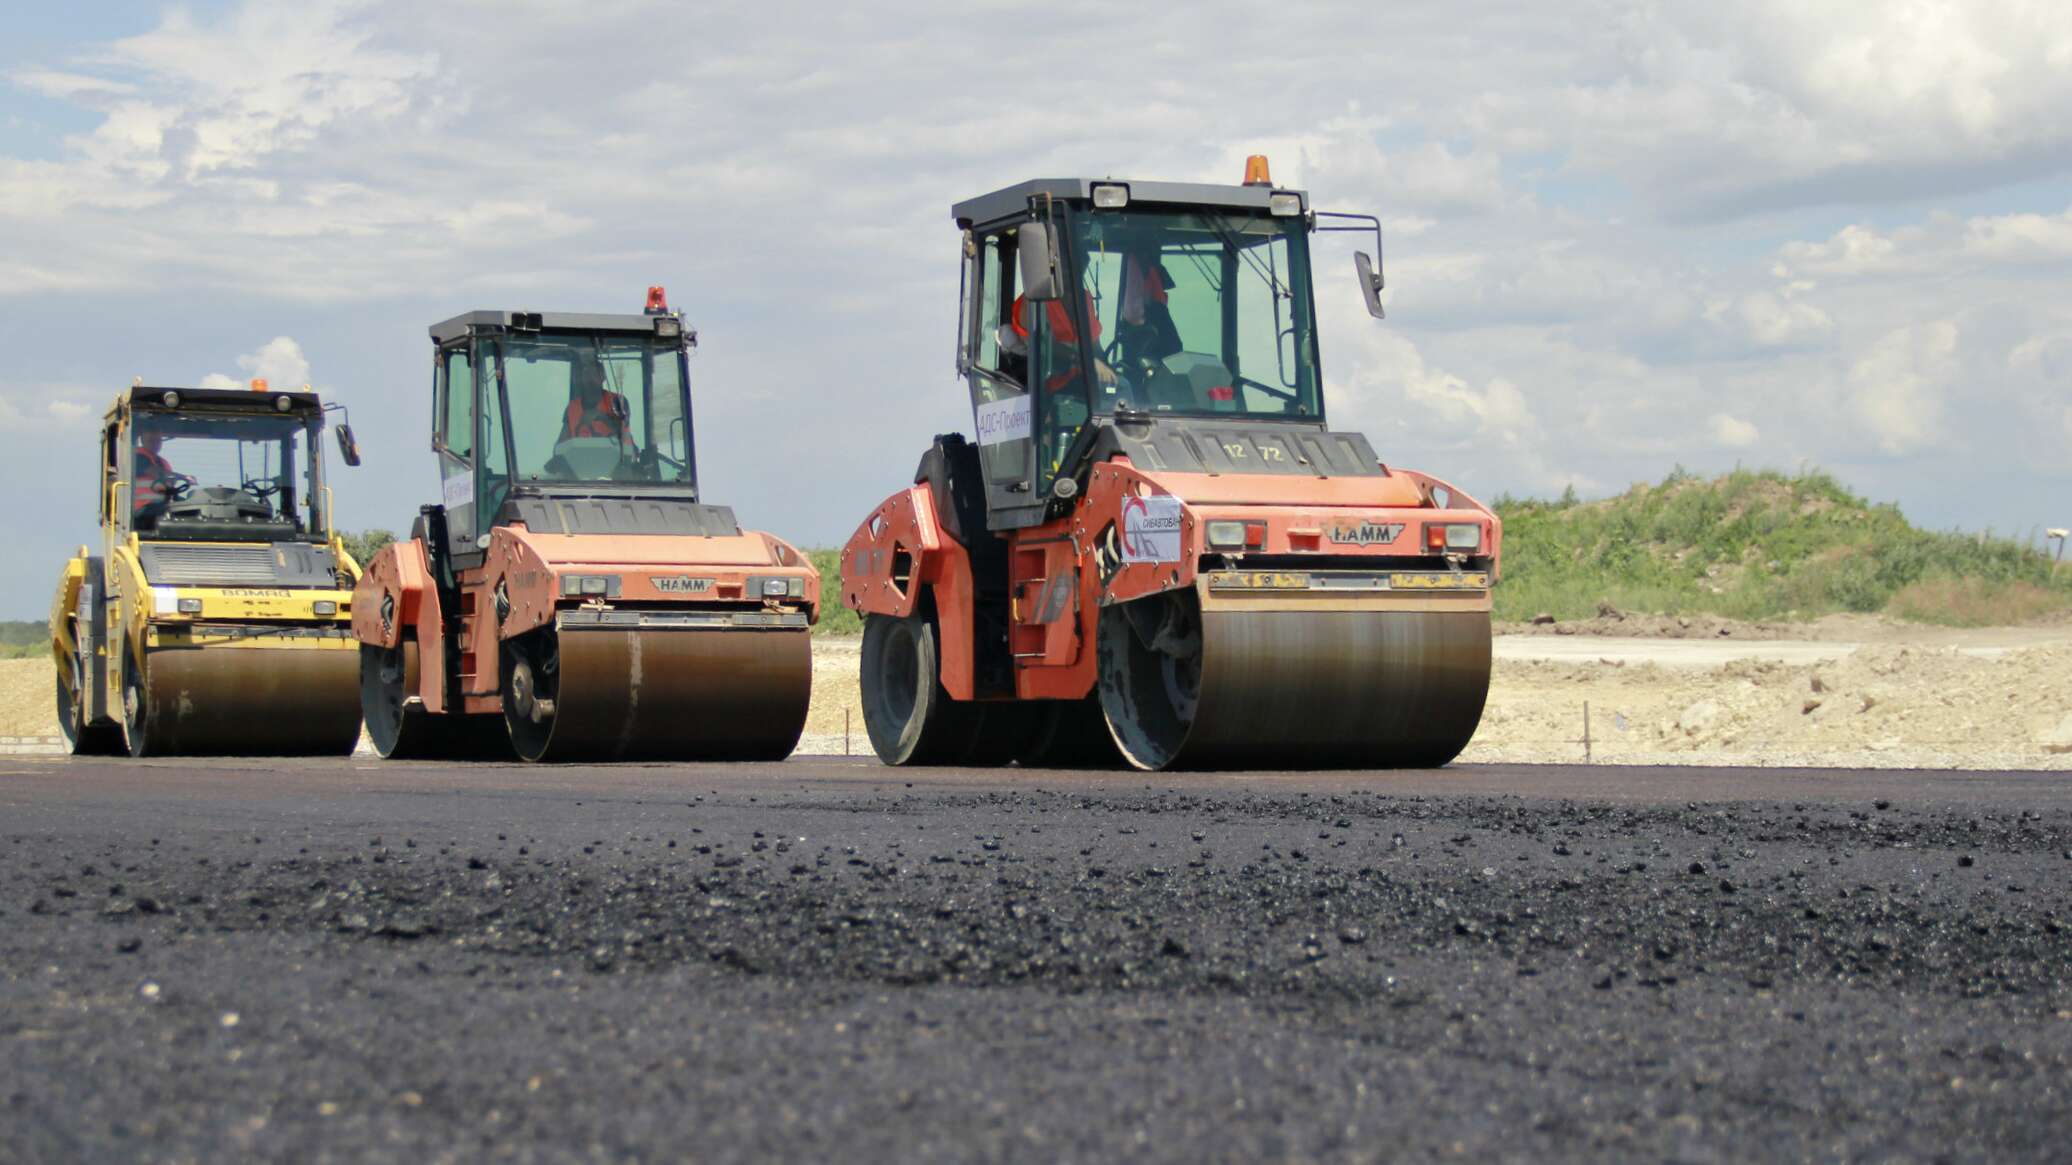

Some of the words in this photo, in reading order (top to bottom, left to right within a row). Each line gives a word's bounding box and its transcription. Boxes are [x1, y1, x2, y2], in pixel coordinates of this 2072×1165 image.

[1223, 444, 1247, 457] 12
[1258, 446, 1284, 461] 72
[661, 579, 705, 590] HAMM
